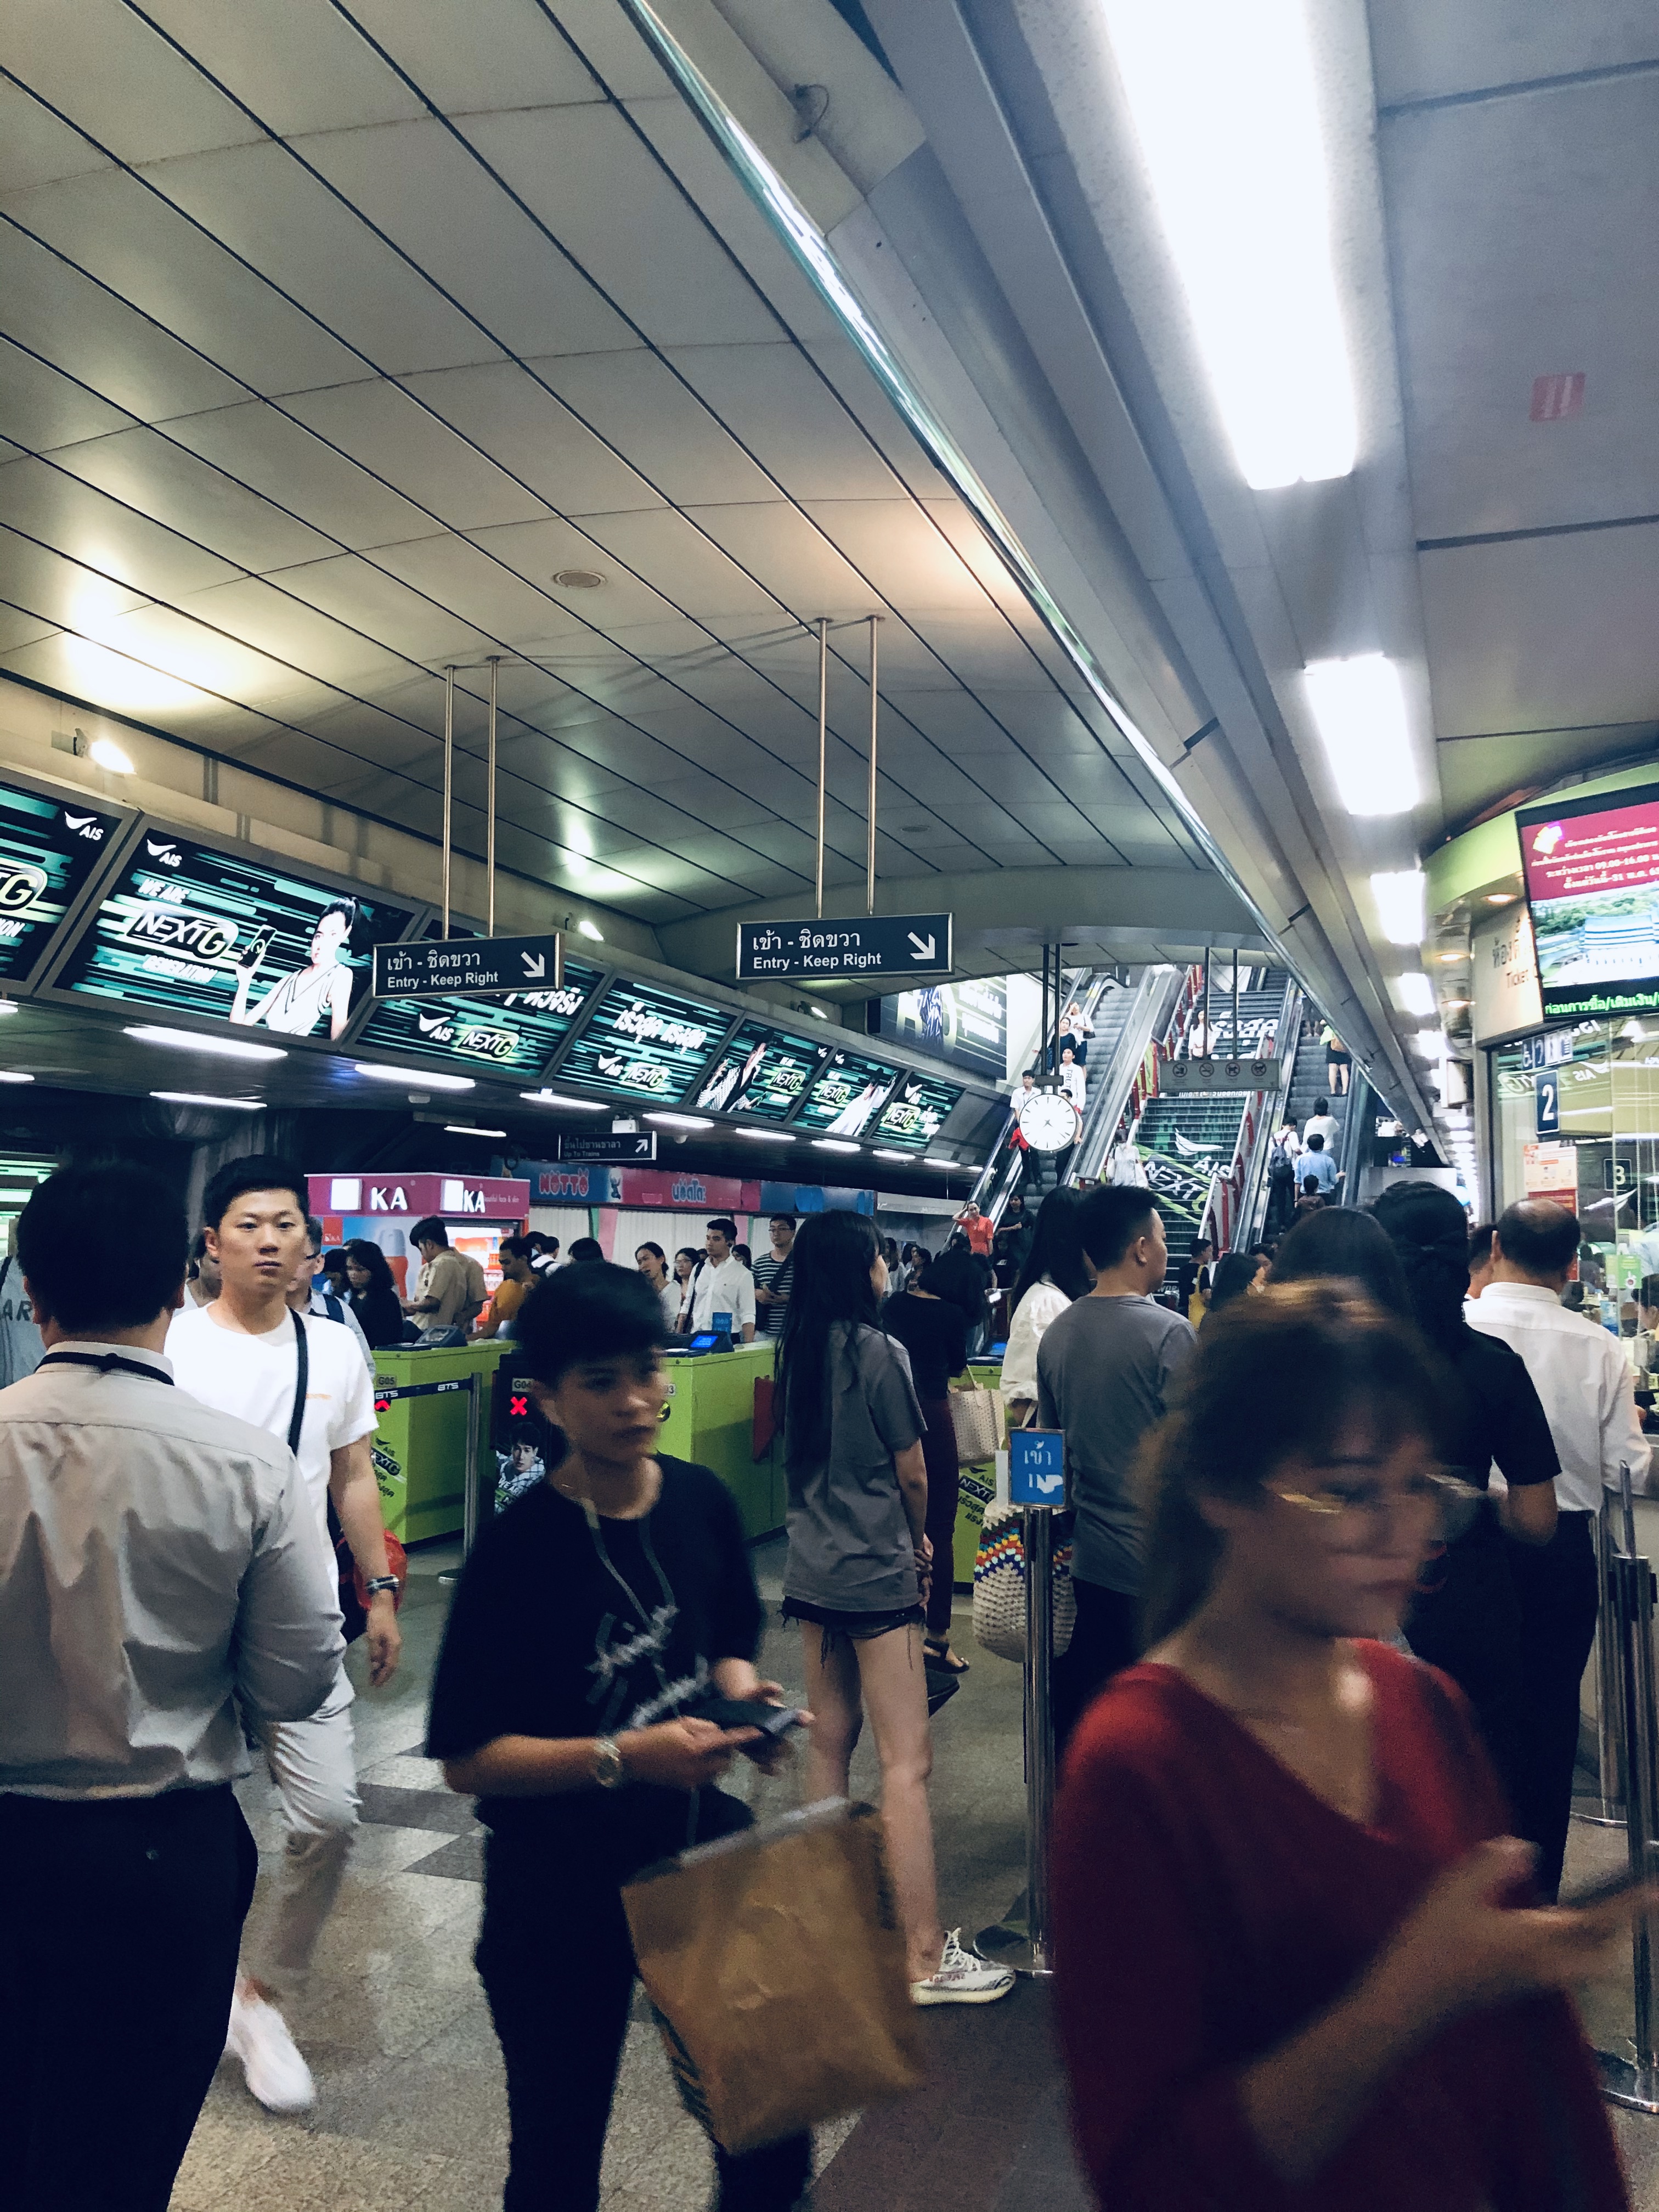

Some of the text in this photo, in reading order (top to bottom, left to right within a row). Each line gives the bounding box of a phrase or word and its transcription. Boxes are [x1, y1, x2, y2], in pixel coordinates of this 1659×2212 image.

[79, 825, 104, 840] AIS
[159, 852, 182, 867] AIS
[138, 878, 190, 904] WE ARE
[753, 929, 781, 950] เข้า
[799, 928, 860, 949] ชิดขวา
[387, 950, 412, 970] เข้า
[427, 949, 481, 968] ชิดขวา
[753, 956, 790, 971] Entry
[803, 955, 839, 969] Keep
[843, 952, 882, 968] Right
[387, 977, 420, 990] Entry
[431, 974, 462, 988] Keep
[465, 972, 499, 986] Right
[1544, 992, 1659, 1014] ก่อนการซื้อ/เติมเงิน/
[429, 1026, 454, 1041] AIS
[1542, 1084, 1554, 1121] 2
[539, 1168, 589, 1197] NOTTO
[370, 1187, 409, 1211] KA
[464, 1189, 486, 1213] KA
[378, 1377, 395, 1385] G05
[438, 1382, 459, 1391] BTS
[375, 1390, 398, 1400] BTS
[1024, 1440, 1052, 1466] เข้า
[979, 1475, 994, 1486] AIS
